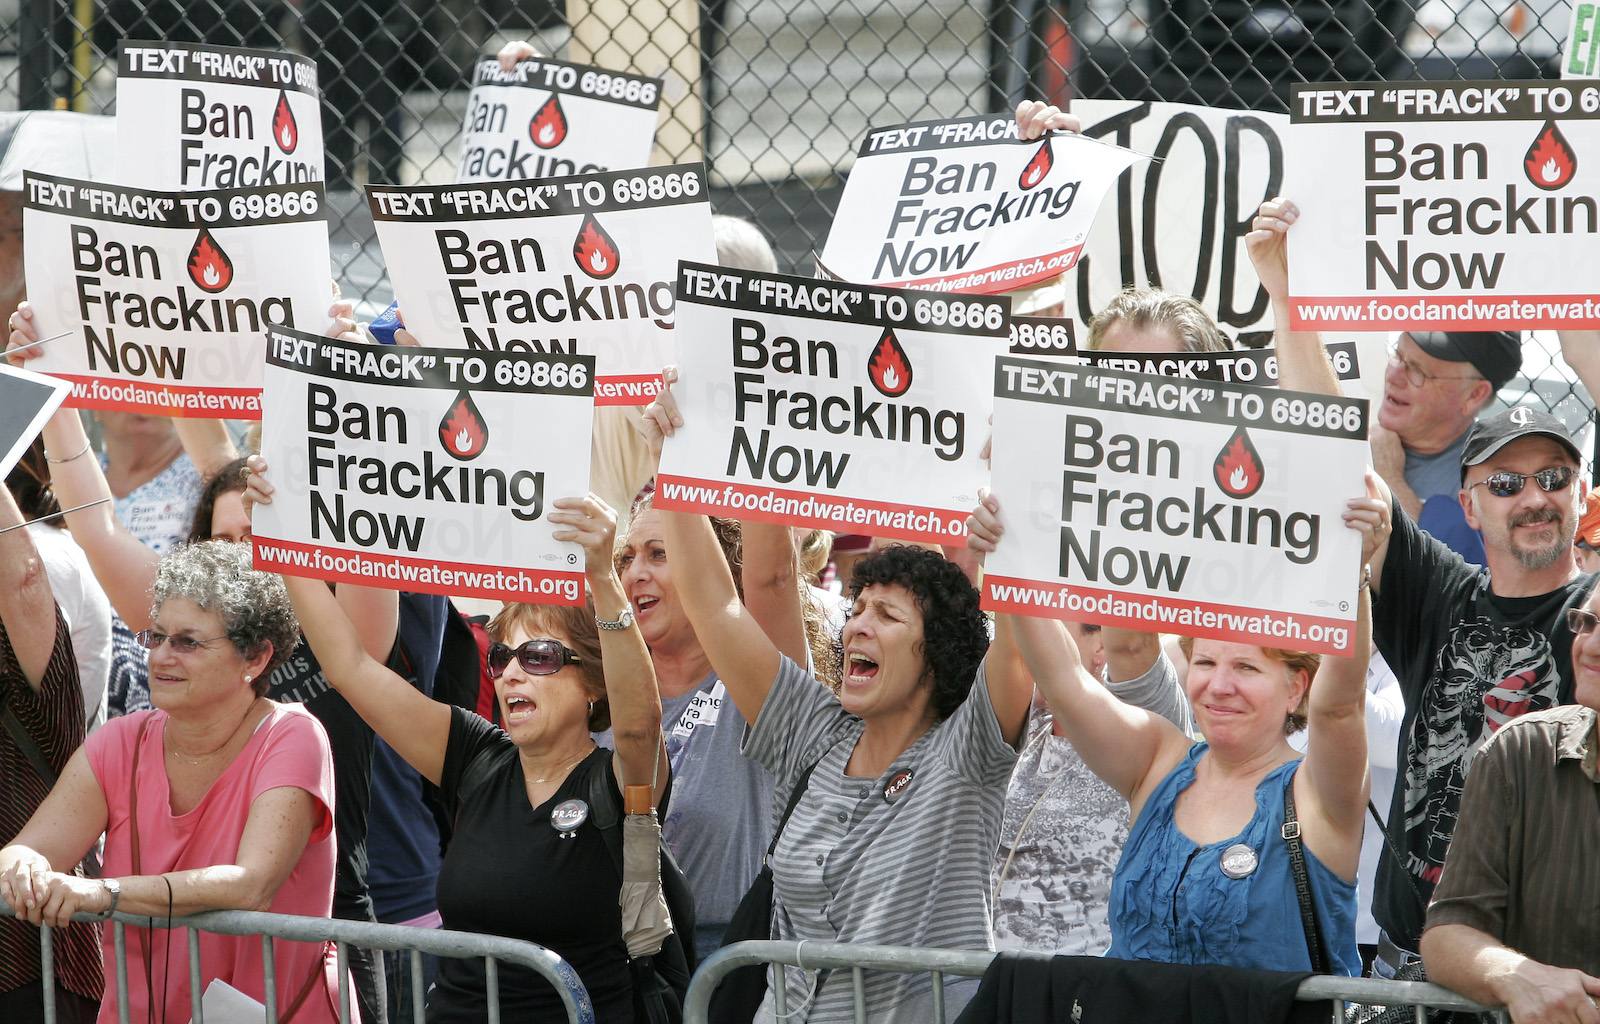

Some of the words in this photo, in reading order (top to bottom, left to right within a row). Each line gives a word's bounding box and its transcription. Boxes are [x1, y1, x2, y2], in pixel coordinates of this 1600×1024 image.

[124, 47, 188, 73] TEXT
[192, 52, 265, 80] “FRACK”
[269, 59, 293, 84] TO
[542, 63, 577, 89] TO
[580, 71, 657, 105] 69866
[180, 87, 254, 140] Ban
[1298, 90, 1375, 117] TEXT
[1382, 87, 1520, 114] “FRACK”
[1527, 86, 1573, 113] TO
[462, 140, 609, 179] rackin
[868, 126, 929, 151] TEXT
[1364, 130, 1488, 181] Ban
[26, 177, 75, 209] TEXT
[79, 189, 175, 222] “FRACK”
[180, 198, 222, 223] TO
[228, 191, 319, 220] 69866
[372, 191, 435, 217] TEXT
[441, 184, 557, 215] “FRACK”
[564, 180, 606, 208] TO
[612, 171, 700, 202] 69866
[899, 156, 998, 197] Ban
[886, 180, 1082, 240] Fracking
[1364, 184, 1598, 236] Frackin
[70, 223, 162, 281] Ban
[434, 228, 546, 275] Ban
[872, 241, 981, 280] Now
[1365, 239, 1506, 291] Now
[75, 274, 295, 333] Fracking
[448, 274, 677, 330] Fracking
[682, 267, 743, 302] TEXT
[748, 279, 862, 316] “FRACK”
[868, 292, 908, 321] TO
[913, 299, 1004, 330] 69866
[83, 325, 186, 380] Now
[270, 332, 317, 367] TEXT
[320, 344, 436, 382] “FRACK”
[443, 356, 488, 385] TO
[494, 359, 588, 389] 69866
[731, 317, 839, 379] Ban
[1215, 357, 1259, 382] TO
[307, 381, 408, 444] Ban
[733, 371, 965, 462] Fracking
[1002, 365, 1078, 399] TEXT
[1084, 375, 1215, 414] “FRACK”
[1221, 392, 1264, 421] TO
[1271, 398, 1362, 432] 69866
[725, 425, 851, 490] Now
[1063, 414, 1181, 480] Ban
[307, 436, 546, 522] Fracking
[309, 489, 426, 552] Now
[1061, 470, 1321, 565] Fracking
[258, 543, 580, 601] www.foodandwaterwatch.org
[1058, 525, 1192, 593] Now
[989, 581, 1350, 650] www.foodandwaterwatch.org
[884, 772, 912, 798] FRACK
[551, 809, 585, 819] FRACK
[1222, 851, 1256, 869] FRACK
